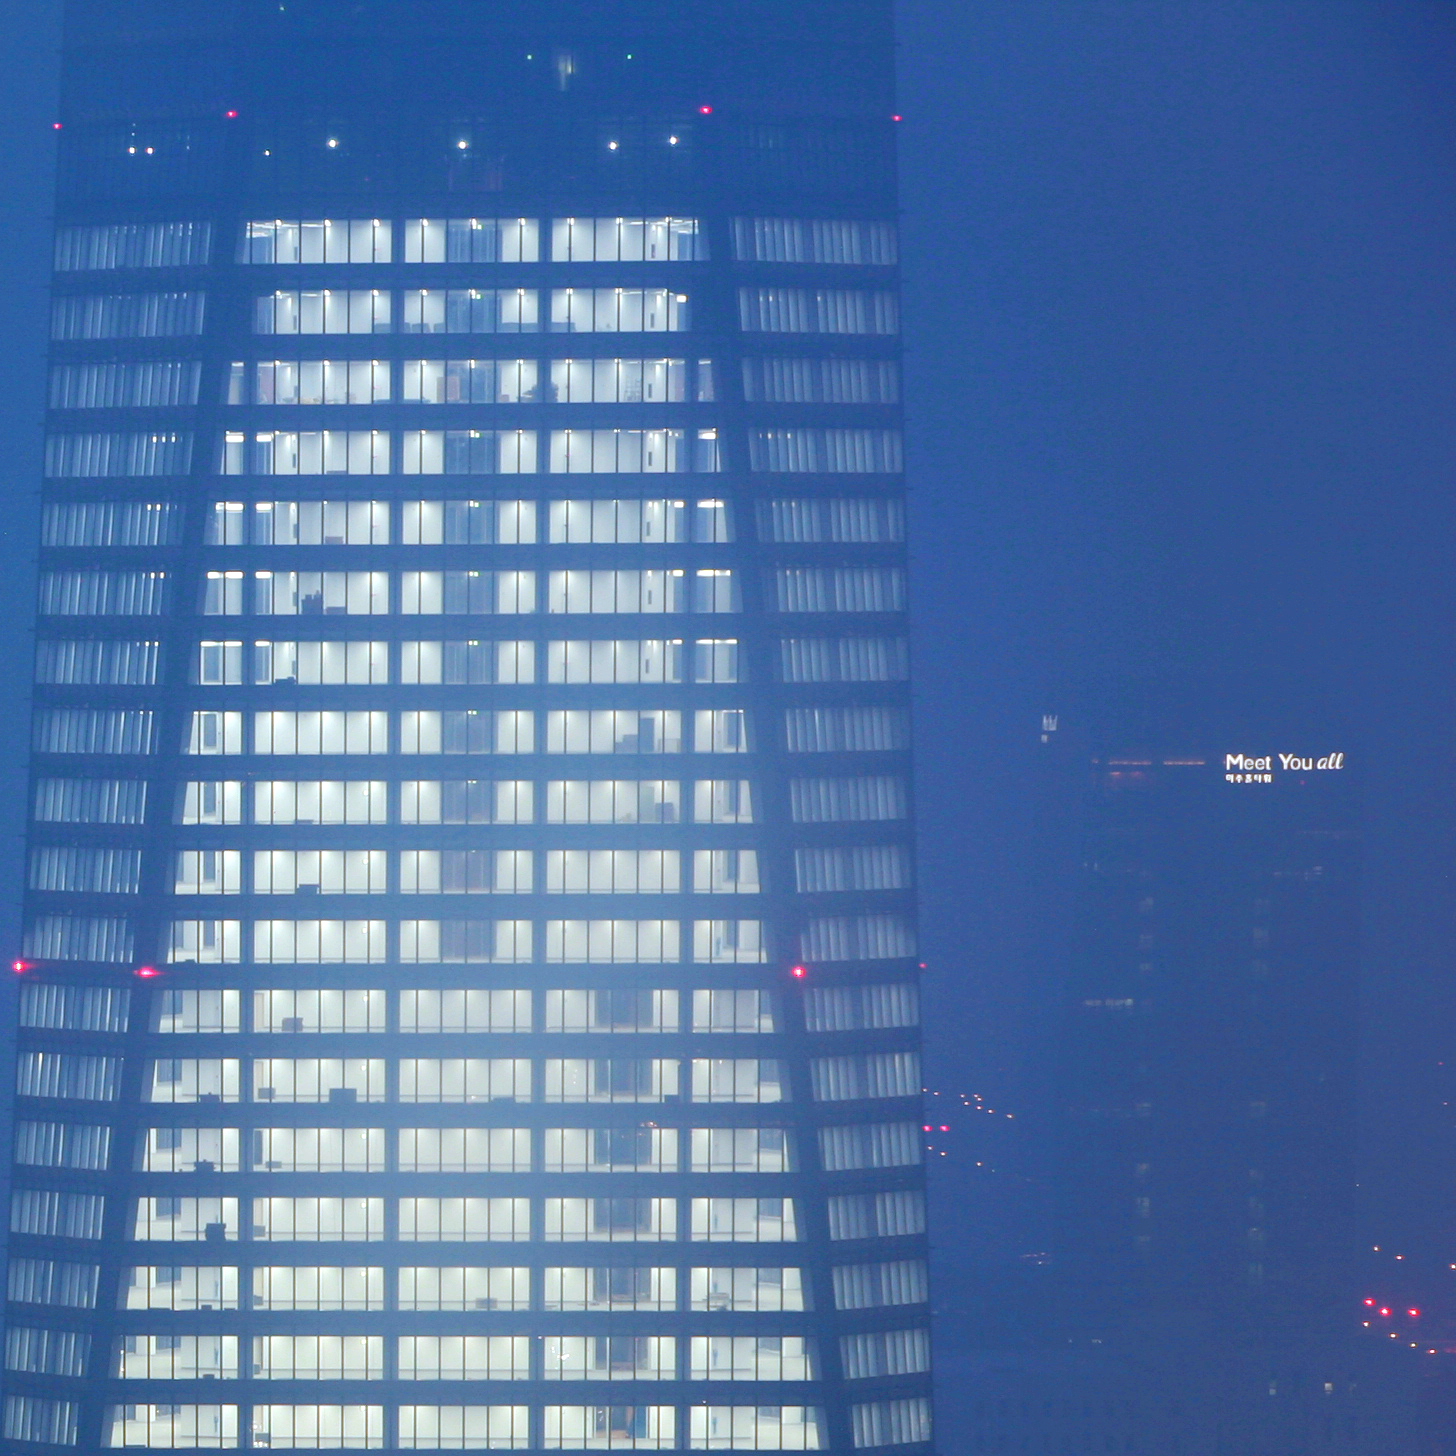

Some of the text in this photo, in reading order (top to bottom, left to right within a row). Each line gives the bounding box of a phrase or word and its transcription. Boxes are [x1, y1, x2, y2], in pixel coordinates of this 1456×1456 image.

[1225, 752, 1344, 771] Meet You all
